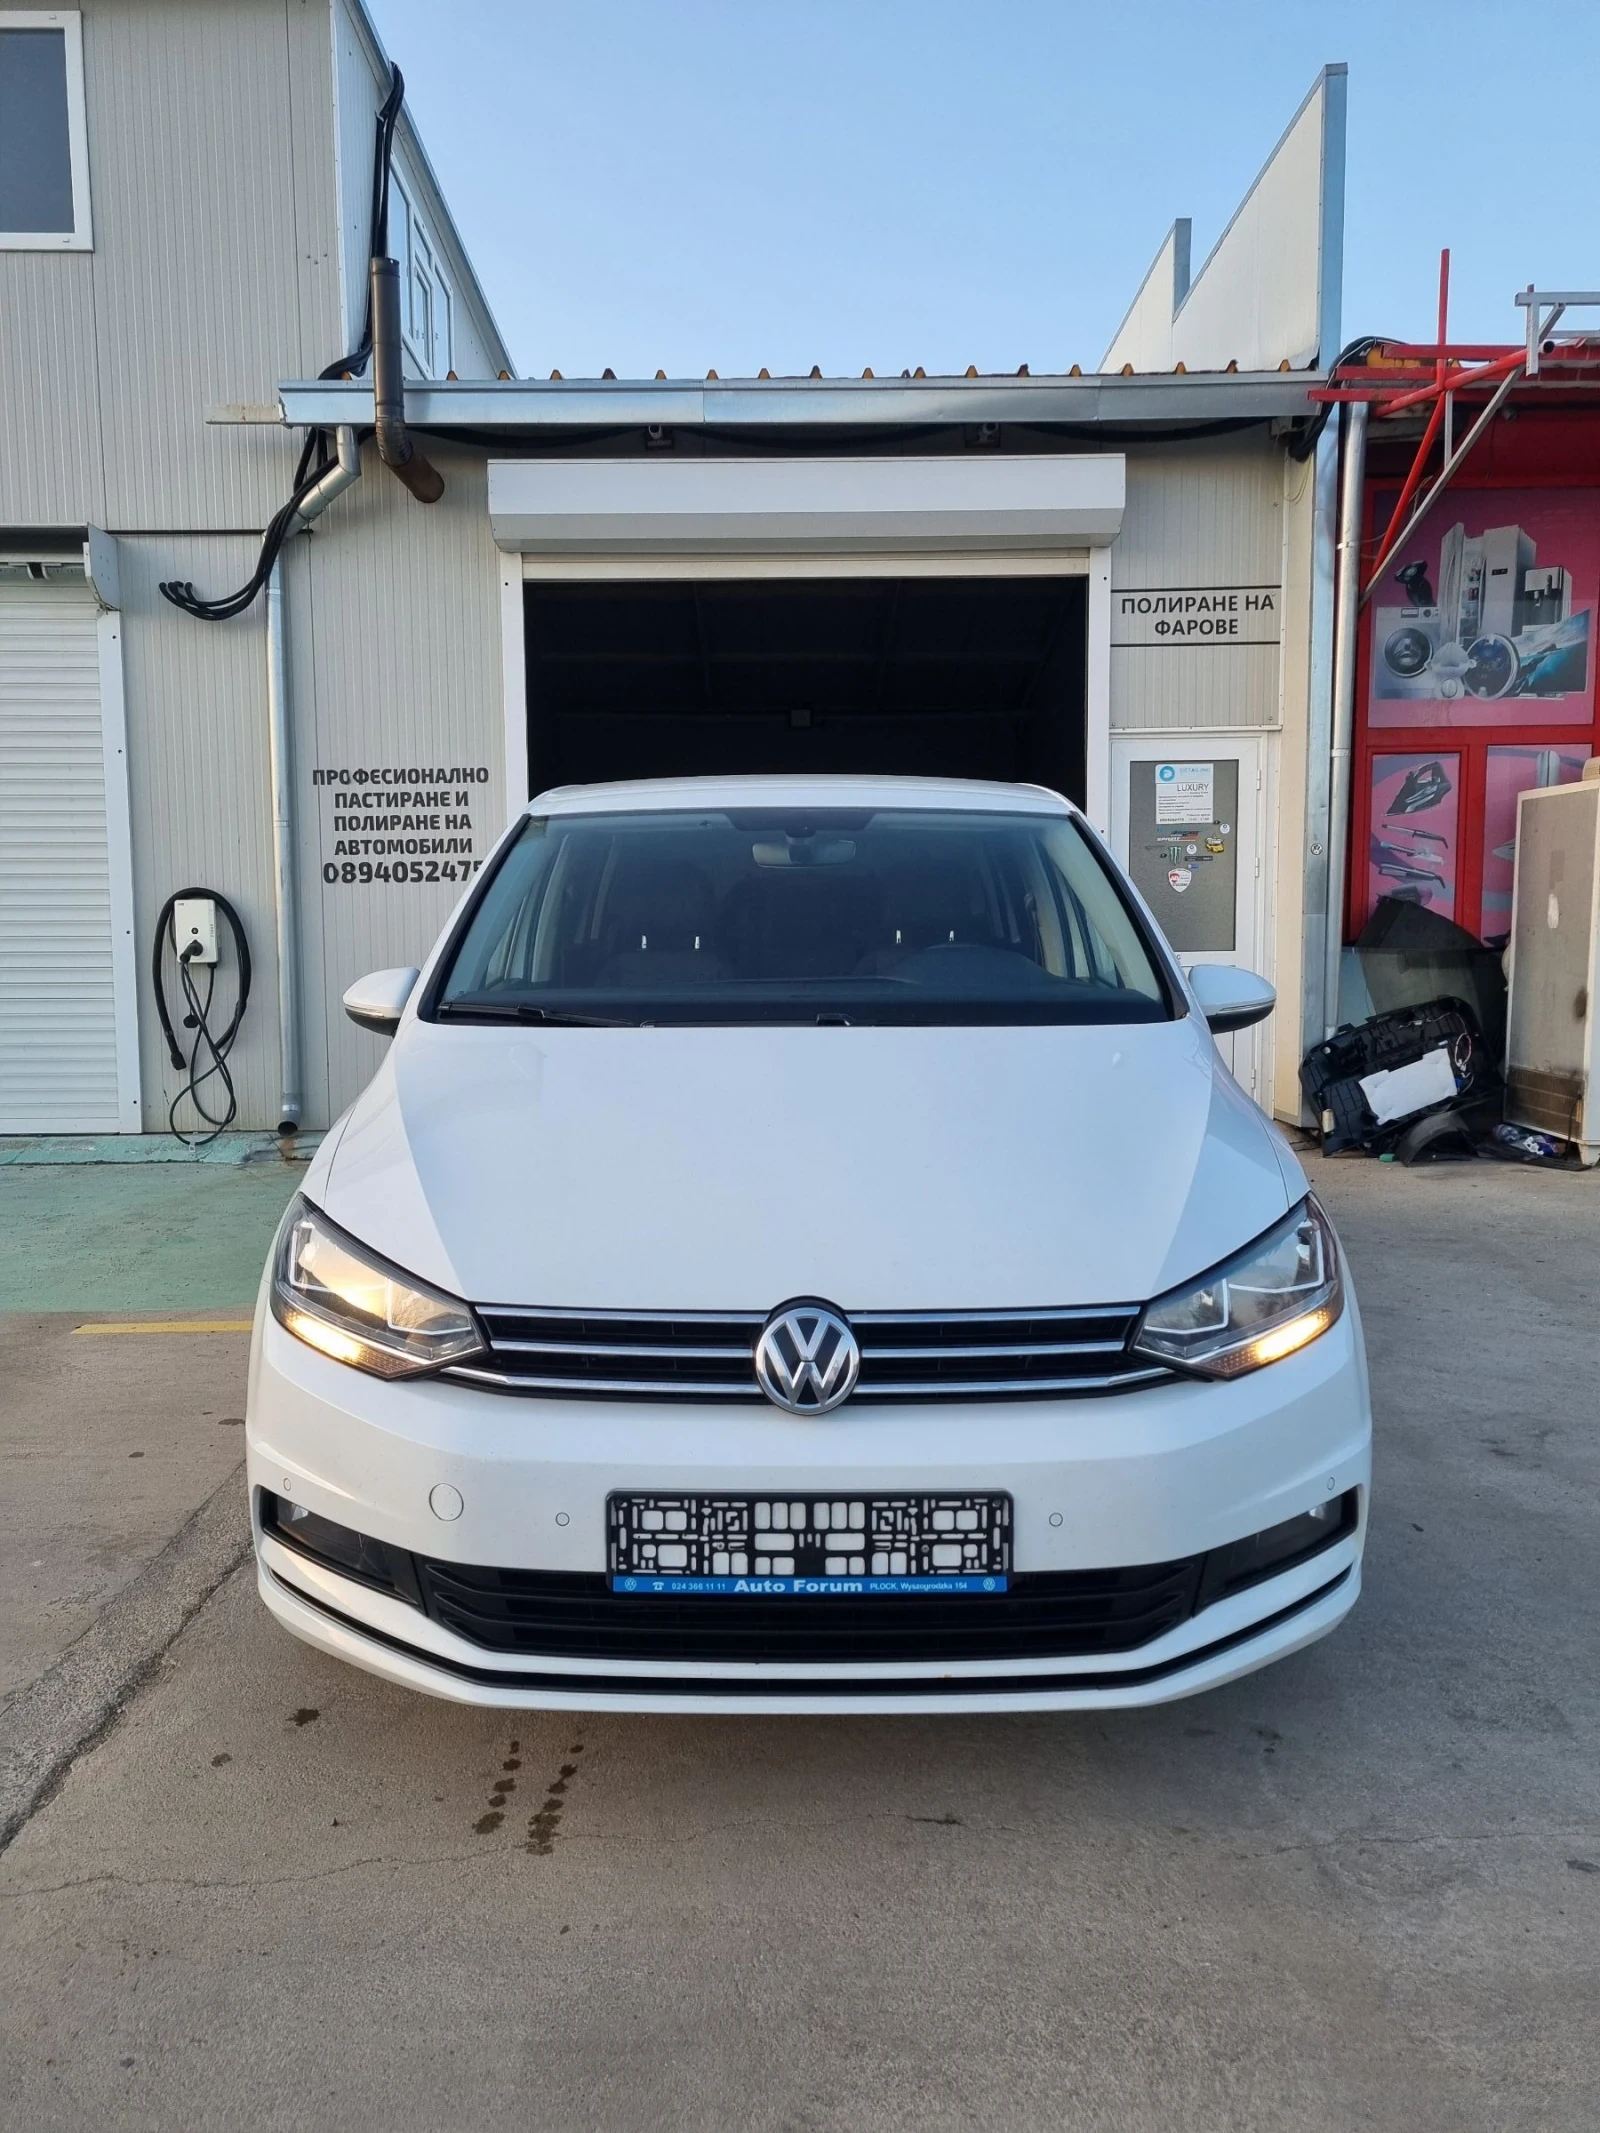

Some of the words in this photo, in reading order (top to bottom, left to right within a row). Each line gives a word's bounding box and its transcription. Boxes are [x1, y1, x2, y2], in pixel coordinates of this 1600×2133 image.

[1121, 595, 1238, 614] ПОЛИРАНЕ
[1245, 594, 1274, 611] НА
[1154, 618, 1239, 636] ФАРОВЕ
[312, 767, 489, 786] ПРОФЕСИОНАЛНО
[1176, 783, 1210, 792] LUXURY
[334, 791, 451, 809] ПАСТИРАНЕ
[455, 790, 469, 807] И
[334, 814, 441, 831] ПОЛИРАНЕ
[445, 814, 472, 830] НА
[334, 838, 473, 856] АВТОМОБИЛИ
[757, 1309, 858, 1413] VW
[733, 1579, 786, 1593] Auto
[793, 1579, 863, 1593] Forum
